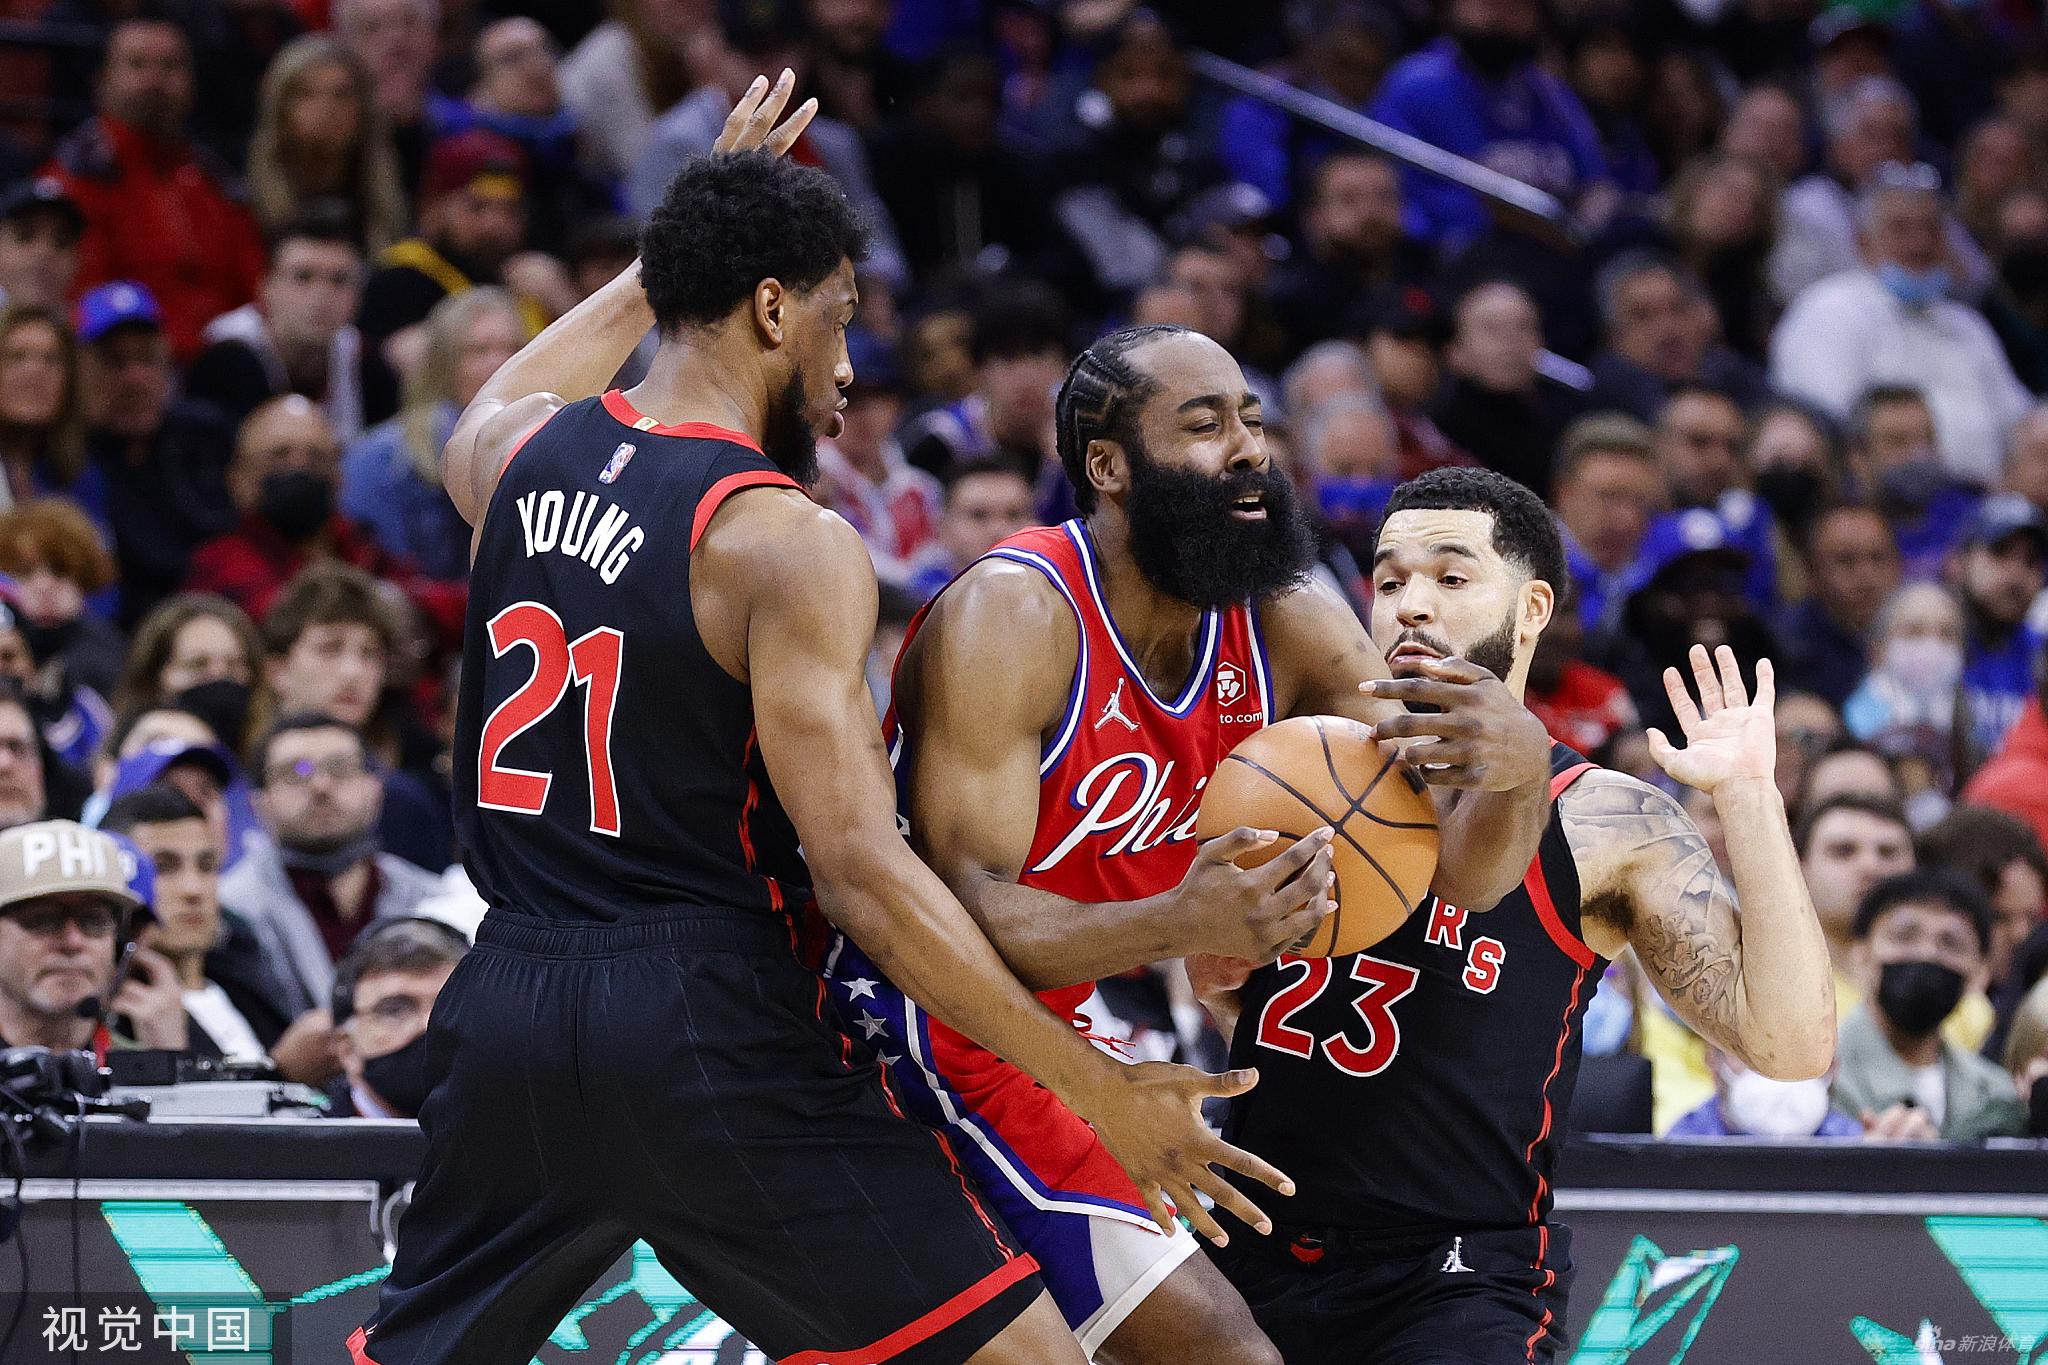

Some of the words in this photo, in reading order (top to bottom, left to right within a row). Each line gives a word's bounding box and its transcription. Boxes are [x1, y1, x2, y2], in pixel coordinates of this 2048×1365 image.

[515, 489, 645, 585] YOUNG
[477, 600, 624, 838] 21
[1026, 752, 1218, 873] Phi
[1422, 889, 1506, 995] RS
[1256, 953, 1420, 1077] 23
